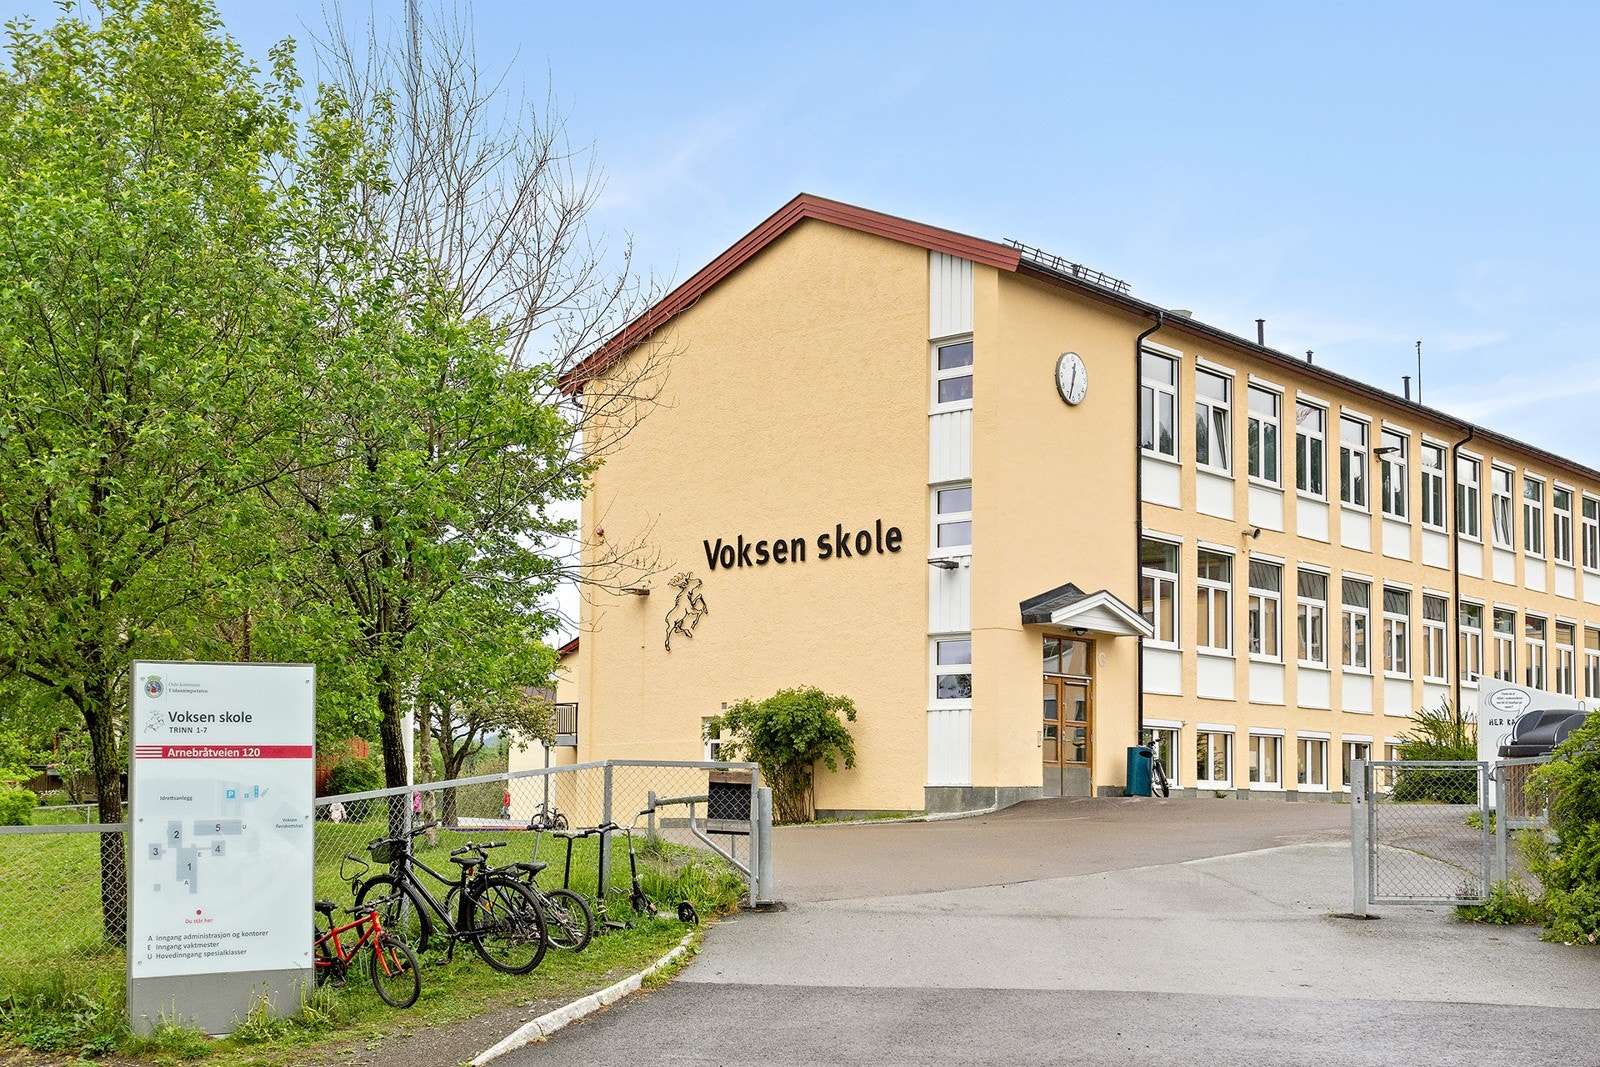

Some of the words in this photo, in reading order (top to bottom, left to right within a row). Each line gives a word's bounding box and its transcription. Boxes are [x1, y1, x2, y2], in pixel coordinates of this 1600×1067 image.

[703, 534, 806, 570] Voksen
[817, 518, 902, 560] skole
[168, 711, 215, 722] Voksen
[220, 711, 252, 722] skole
[168, 747, 239, 757] Arnebråtveien
[242, 748, 260, 757] 120
[215, 824, 221, 832] 5
